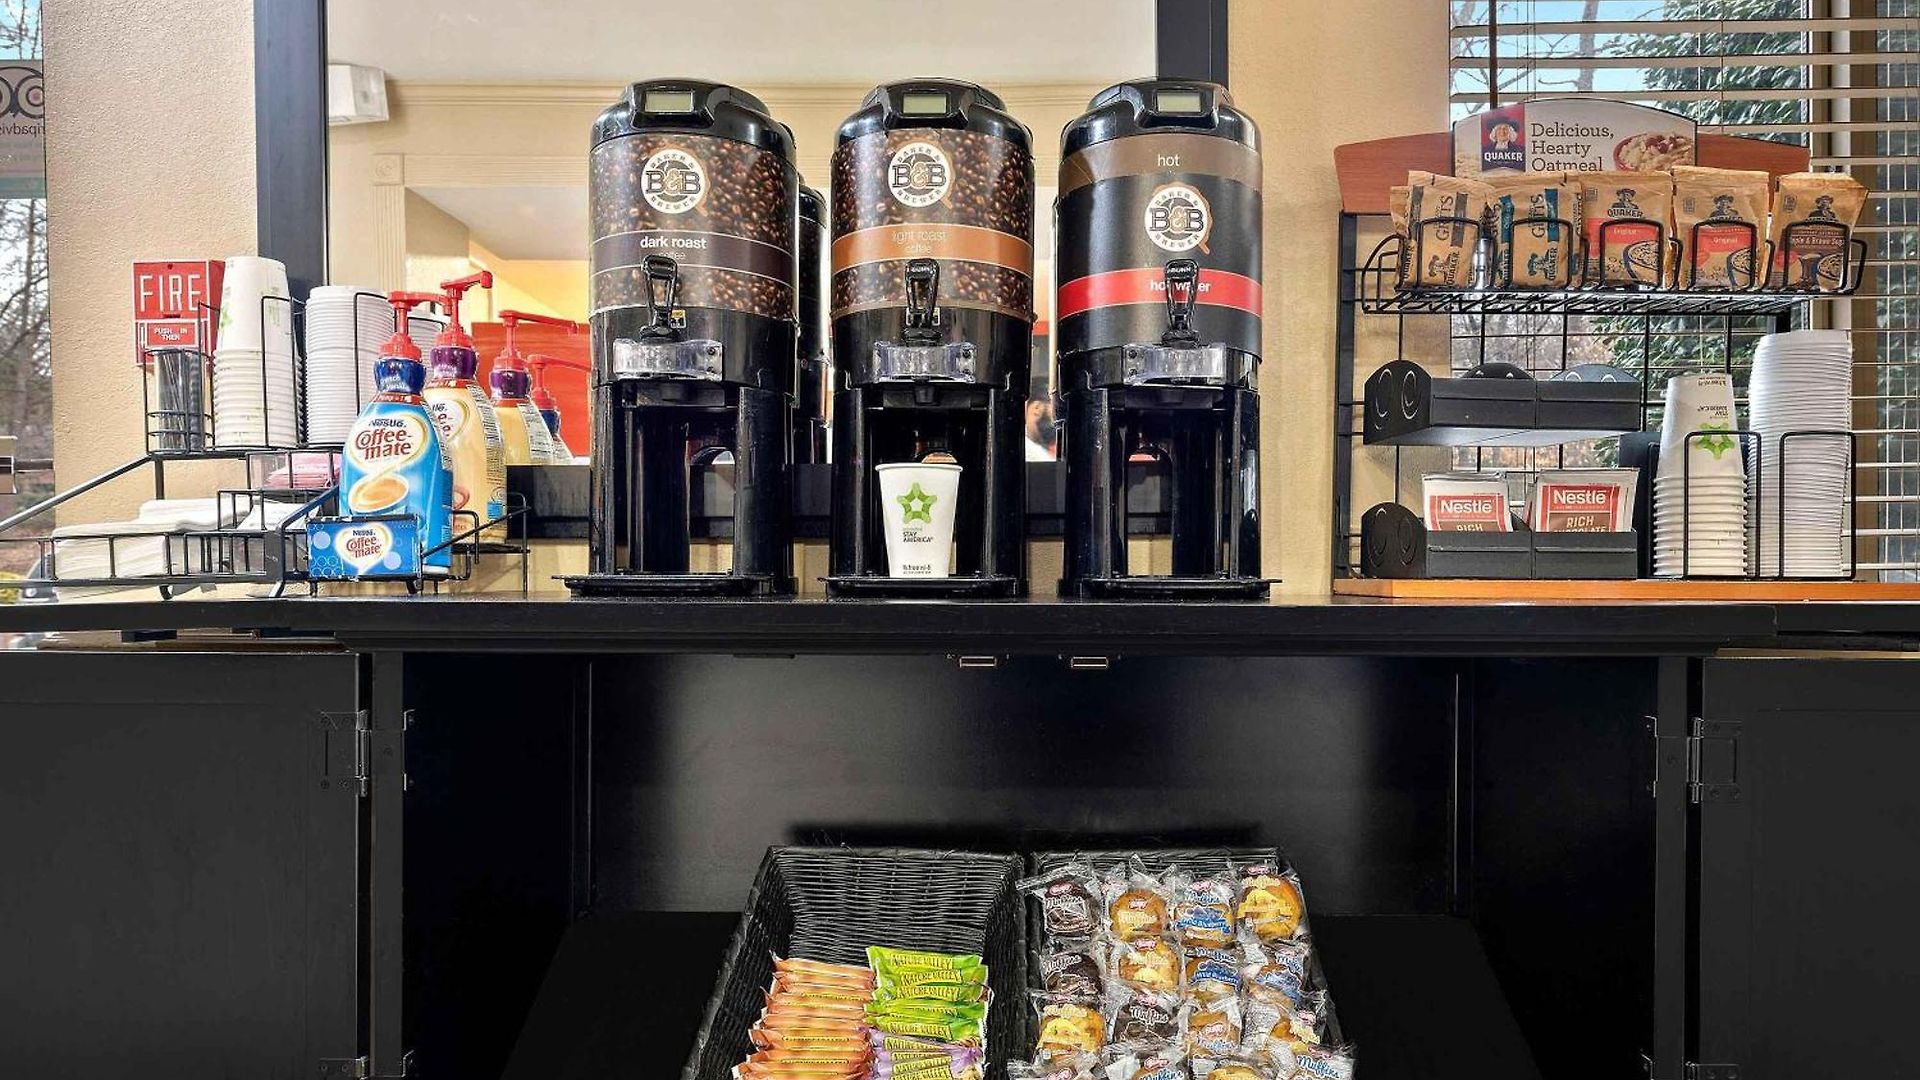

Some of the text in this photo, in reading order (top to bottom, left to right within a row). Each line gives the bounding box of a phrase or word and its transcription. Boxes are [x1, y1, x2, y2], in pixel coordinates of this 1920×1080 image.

[1531, 121, 1614, 139] Delicious,
[1484, 151, 1523, 162] QUAKER
[1531, 140, 1592, 158] Hearty
[1157, 153, 1180, 167] hot
[1531, 157, 1604, 172] Oatmeal
[1607, 208, 1644, 218] QUAKER
[640, 235, 708, 250] dark roast
[916, 230, 947, 242] roast
[1445, 250, 1461, 286] QUAKER
[1548, 247, 1558, 281] QUAKER
[140, 273, 201, 313] FIRE
[154, 327, 173, 335] PUSH
[364, 442, 412, 460] mate
[1456, 523, 1484, 532] RICH
[1566, 515, 1595, 528] RICH
[355, 545, 381, 558] mate
[1297, 1055, 1340, 1079] Muffins
